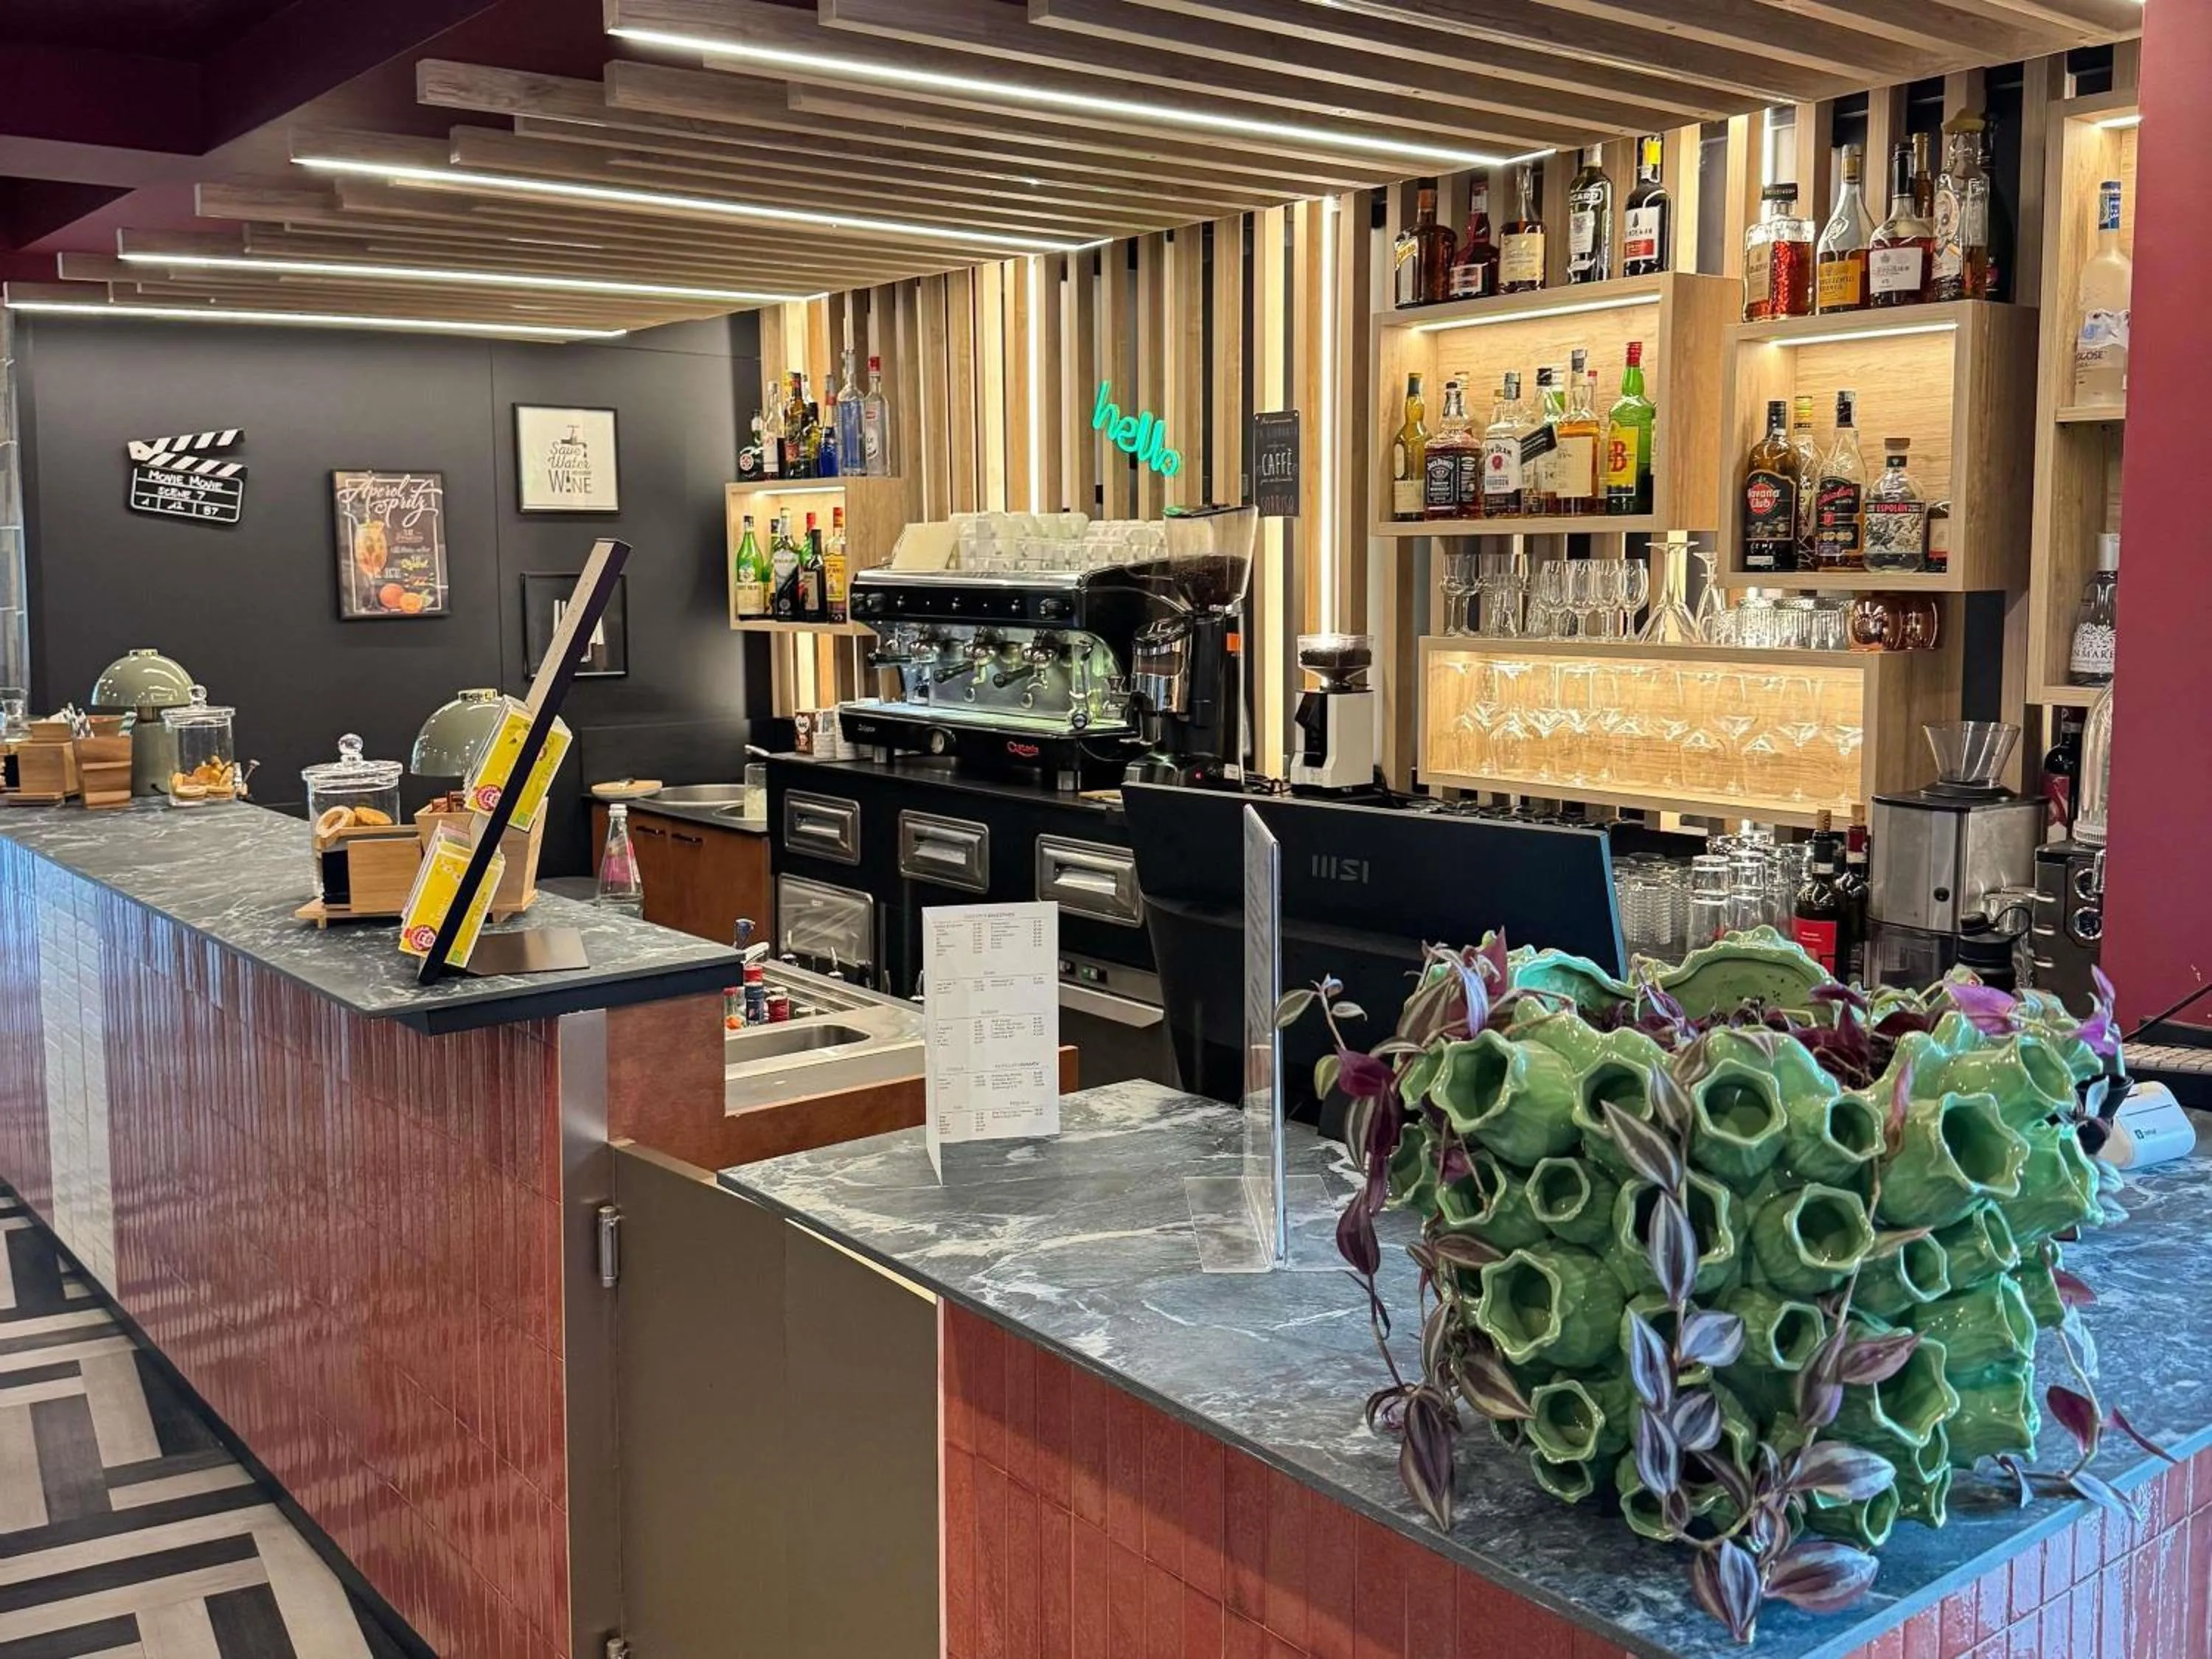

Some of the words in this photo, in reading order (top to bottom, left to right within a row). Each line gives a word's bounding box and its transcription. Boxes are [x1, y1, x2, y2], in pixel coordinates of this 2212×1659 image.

[1092, 380, 1181, 478] hello
[549, 441, 581, 455] Save
[547, 456, 590, 469] Water
[1262, 448, 1293, 477] CAFFÈ
[148, 470, 184, 485] MOVIE
[189, 476, 224, 492] MOVIE
[158, 486, 192, 499] SCENE
[196, 490, 206, 501] 7
[337, 473, 413, 504] Aperol
[548, 469, 592, 493] WINE
[370, 481, 442, 528] Spritz
[1312, 855, 1369, 885] MSI
